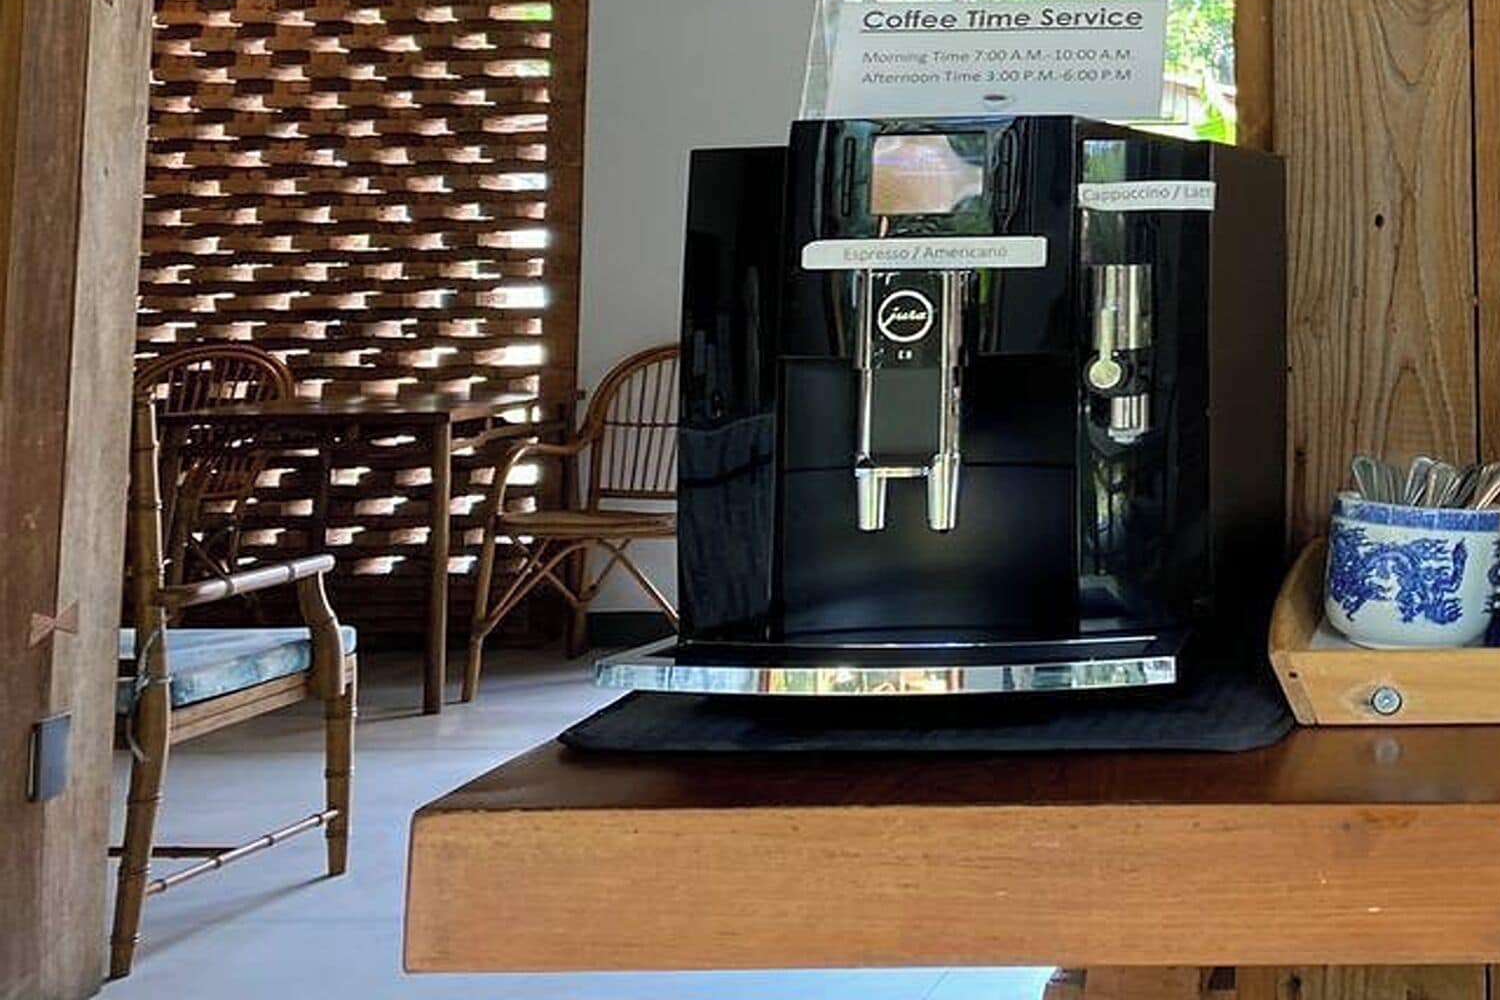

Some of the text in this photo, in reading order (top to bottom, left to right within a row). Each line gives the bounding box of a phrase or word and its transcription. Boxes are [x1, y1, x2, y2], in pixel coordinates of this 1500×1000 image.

[863, 7, 1143, 28] Coffee Time Service
[862, 51, 928, 64] Morning
[933, 50, 970, 62] Time
[974, 49, 1007, 61] 7:00
[861, 72, 940, 84] Afternoon
[945, 70, 981, 82] Time
[843, 248, 909, 263] Espresso
[923, 245, 1010, 259] Americano
